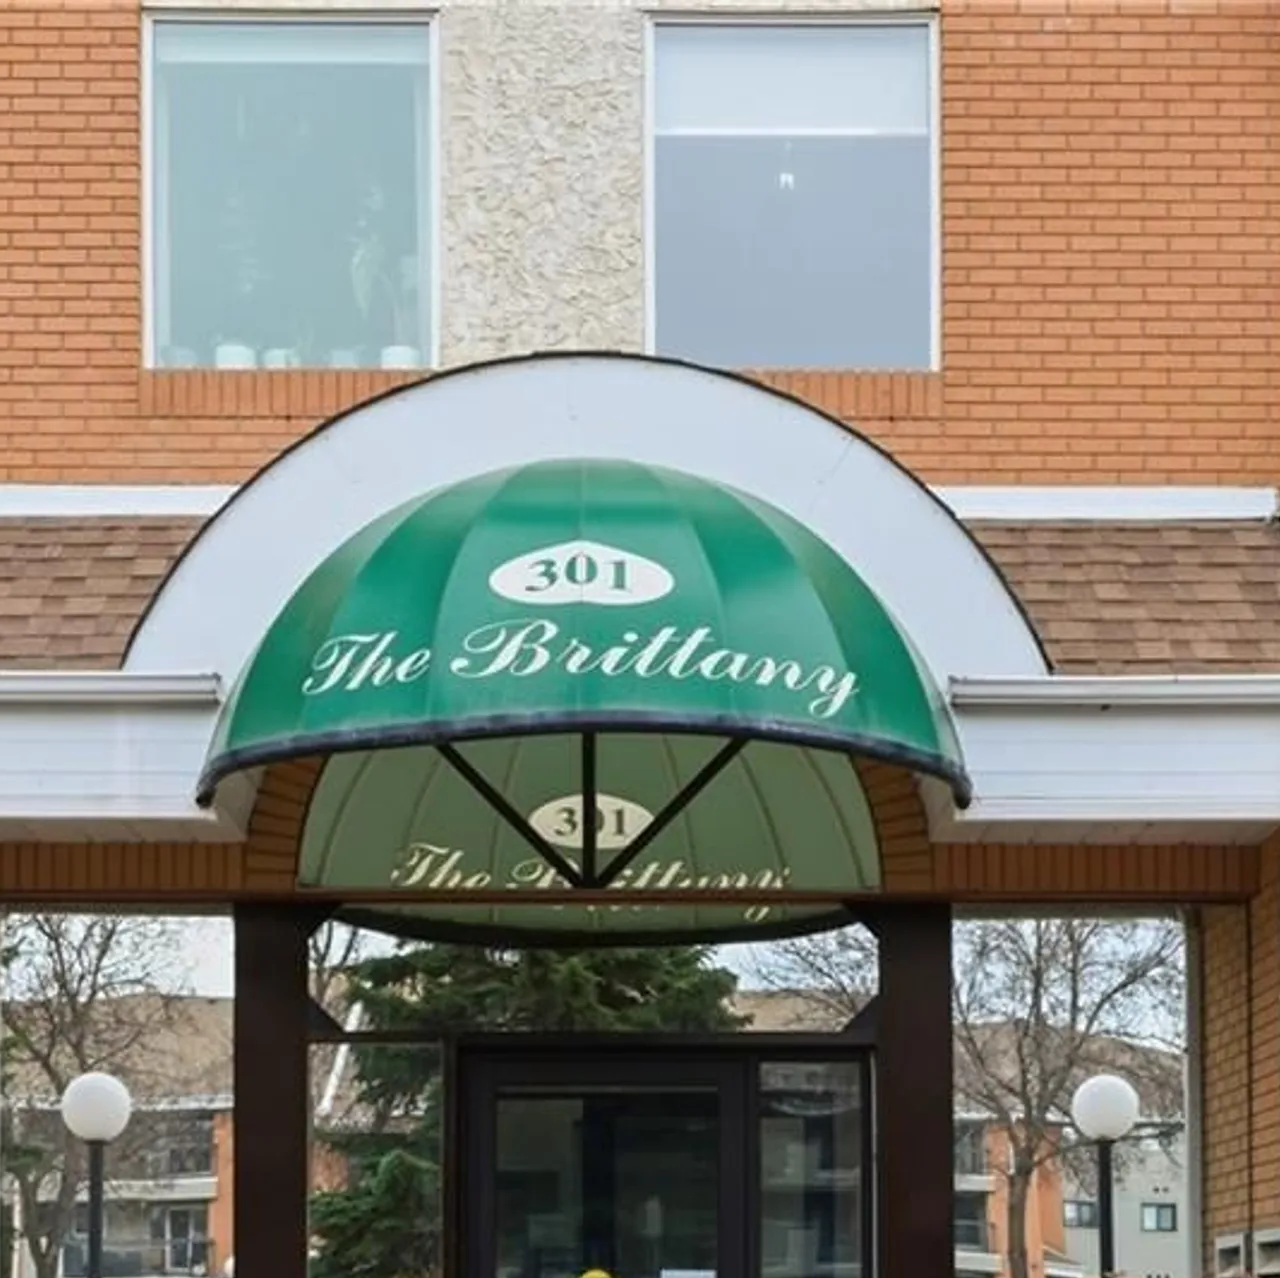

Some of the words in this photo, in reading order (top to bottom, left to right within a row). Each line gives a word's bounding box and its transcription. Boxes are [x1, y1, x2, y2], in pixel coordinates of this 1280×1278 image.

[523, 551, 632, 593] 301
[301, 631, 430, 695] The
[450, 617, 861, 718] Brittany
